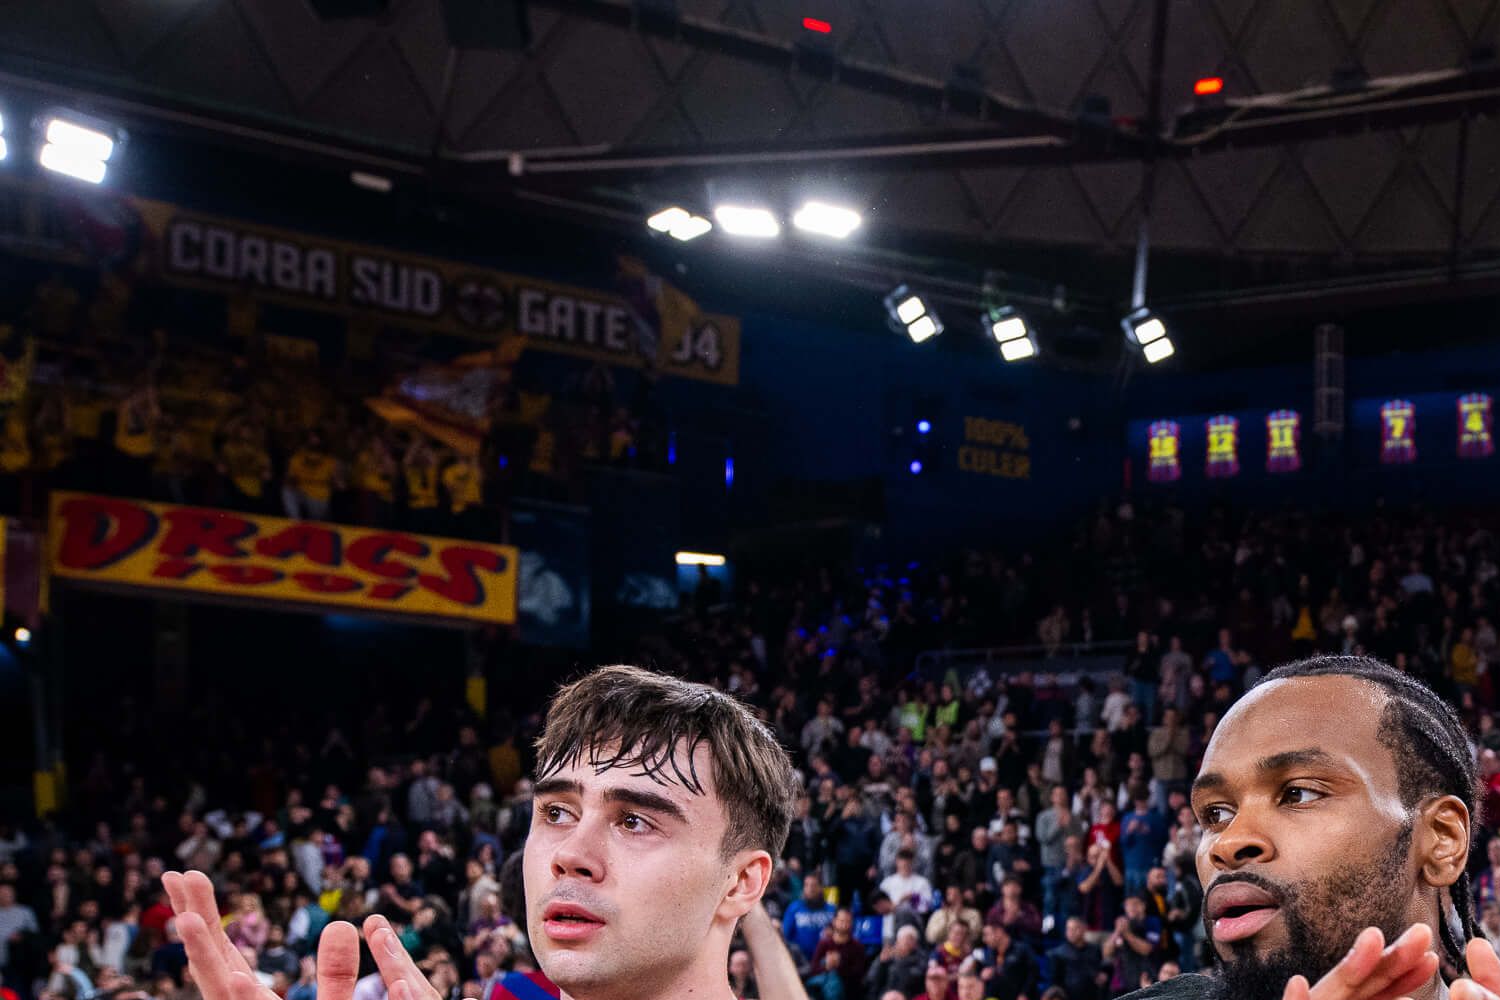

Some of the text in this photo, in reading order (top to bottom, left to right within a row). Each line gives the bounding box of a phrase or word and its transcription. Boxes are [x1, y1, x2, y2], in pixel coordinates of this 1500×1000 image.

[170, 221, 338, 297] CORBA
[350, 255, 443, 319] SUD
[518, 288, 628, 351] GATE
